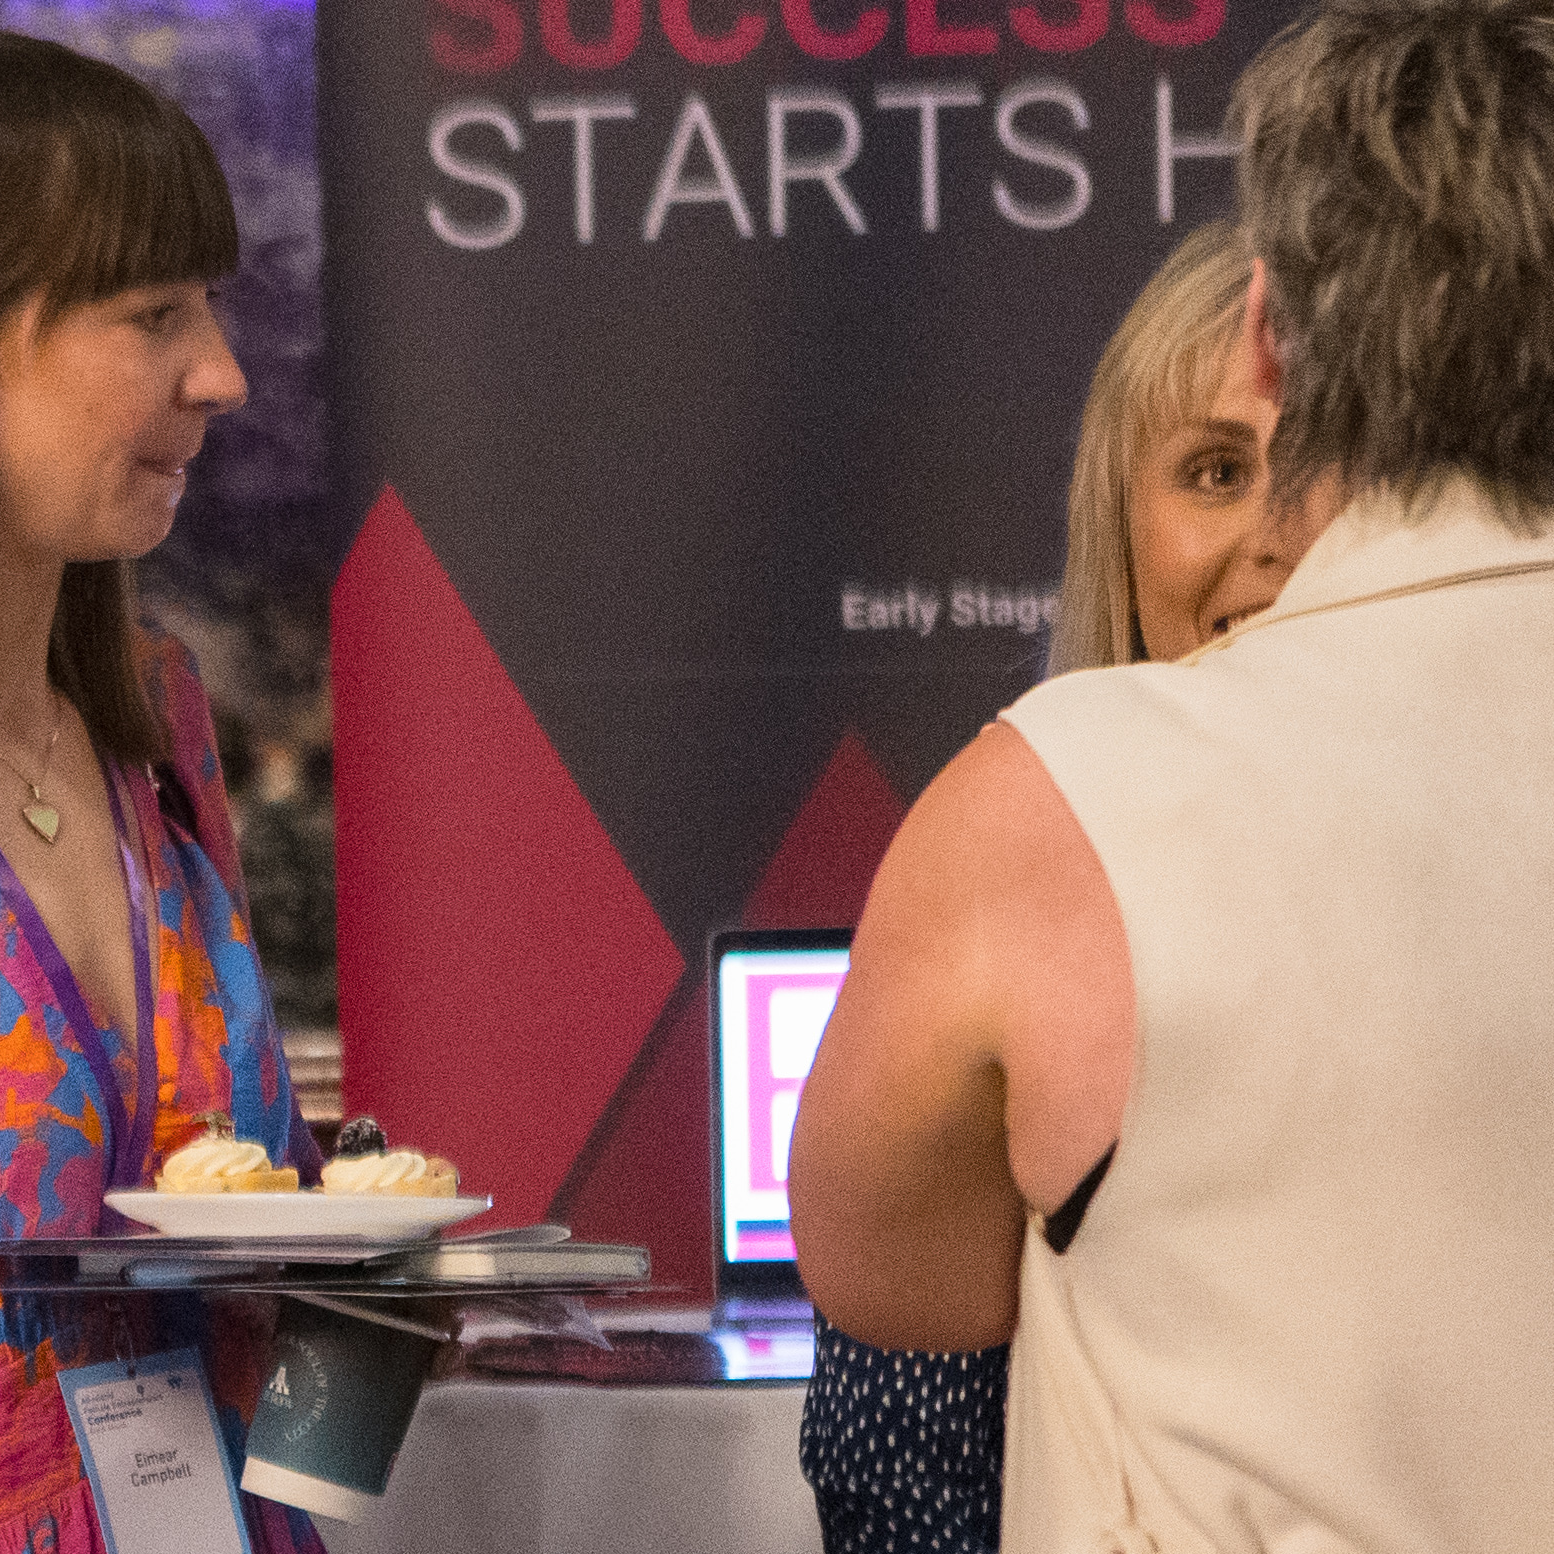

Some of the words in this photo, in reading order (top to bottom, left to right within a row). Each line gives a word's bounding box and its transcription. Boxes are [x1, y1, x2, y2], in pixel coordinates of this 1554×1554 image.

[426, 78, 1092, 250] STARTS
[840, 588, 940, 637] Early
[130, 1463, 192, 1487] Campbell
[134, 1450, 178, 1468] Eimear
